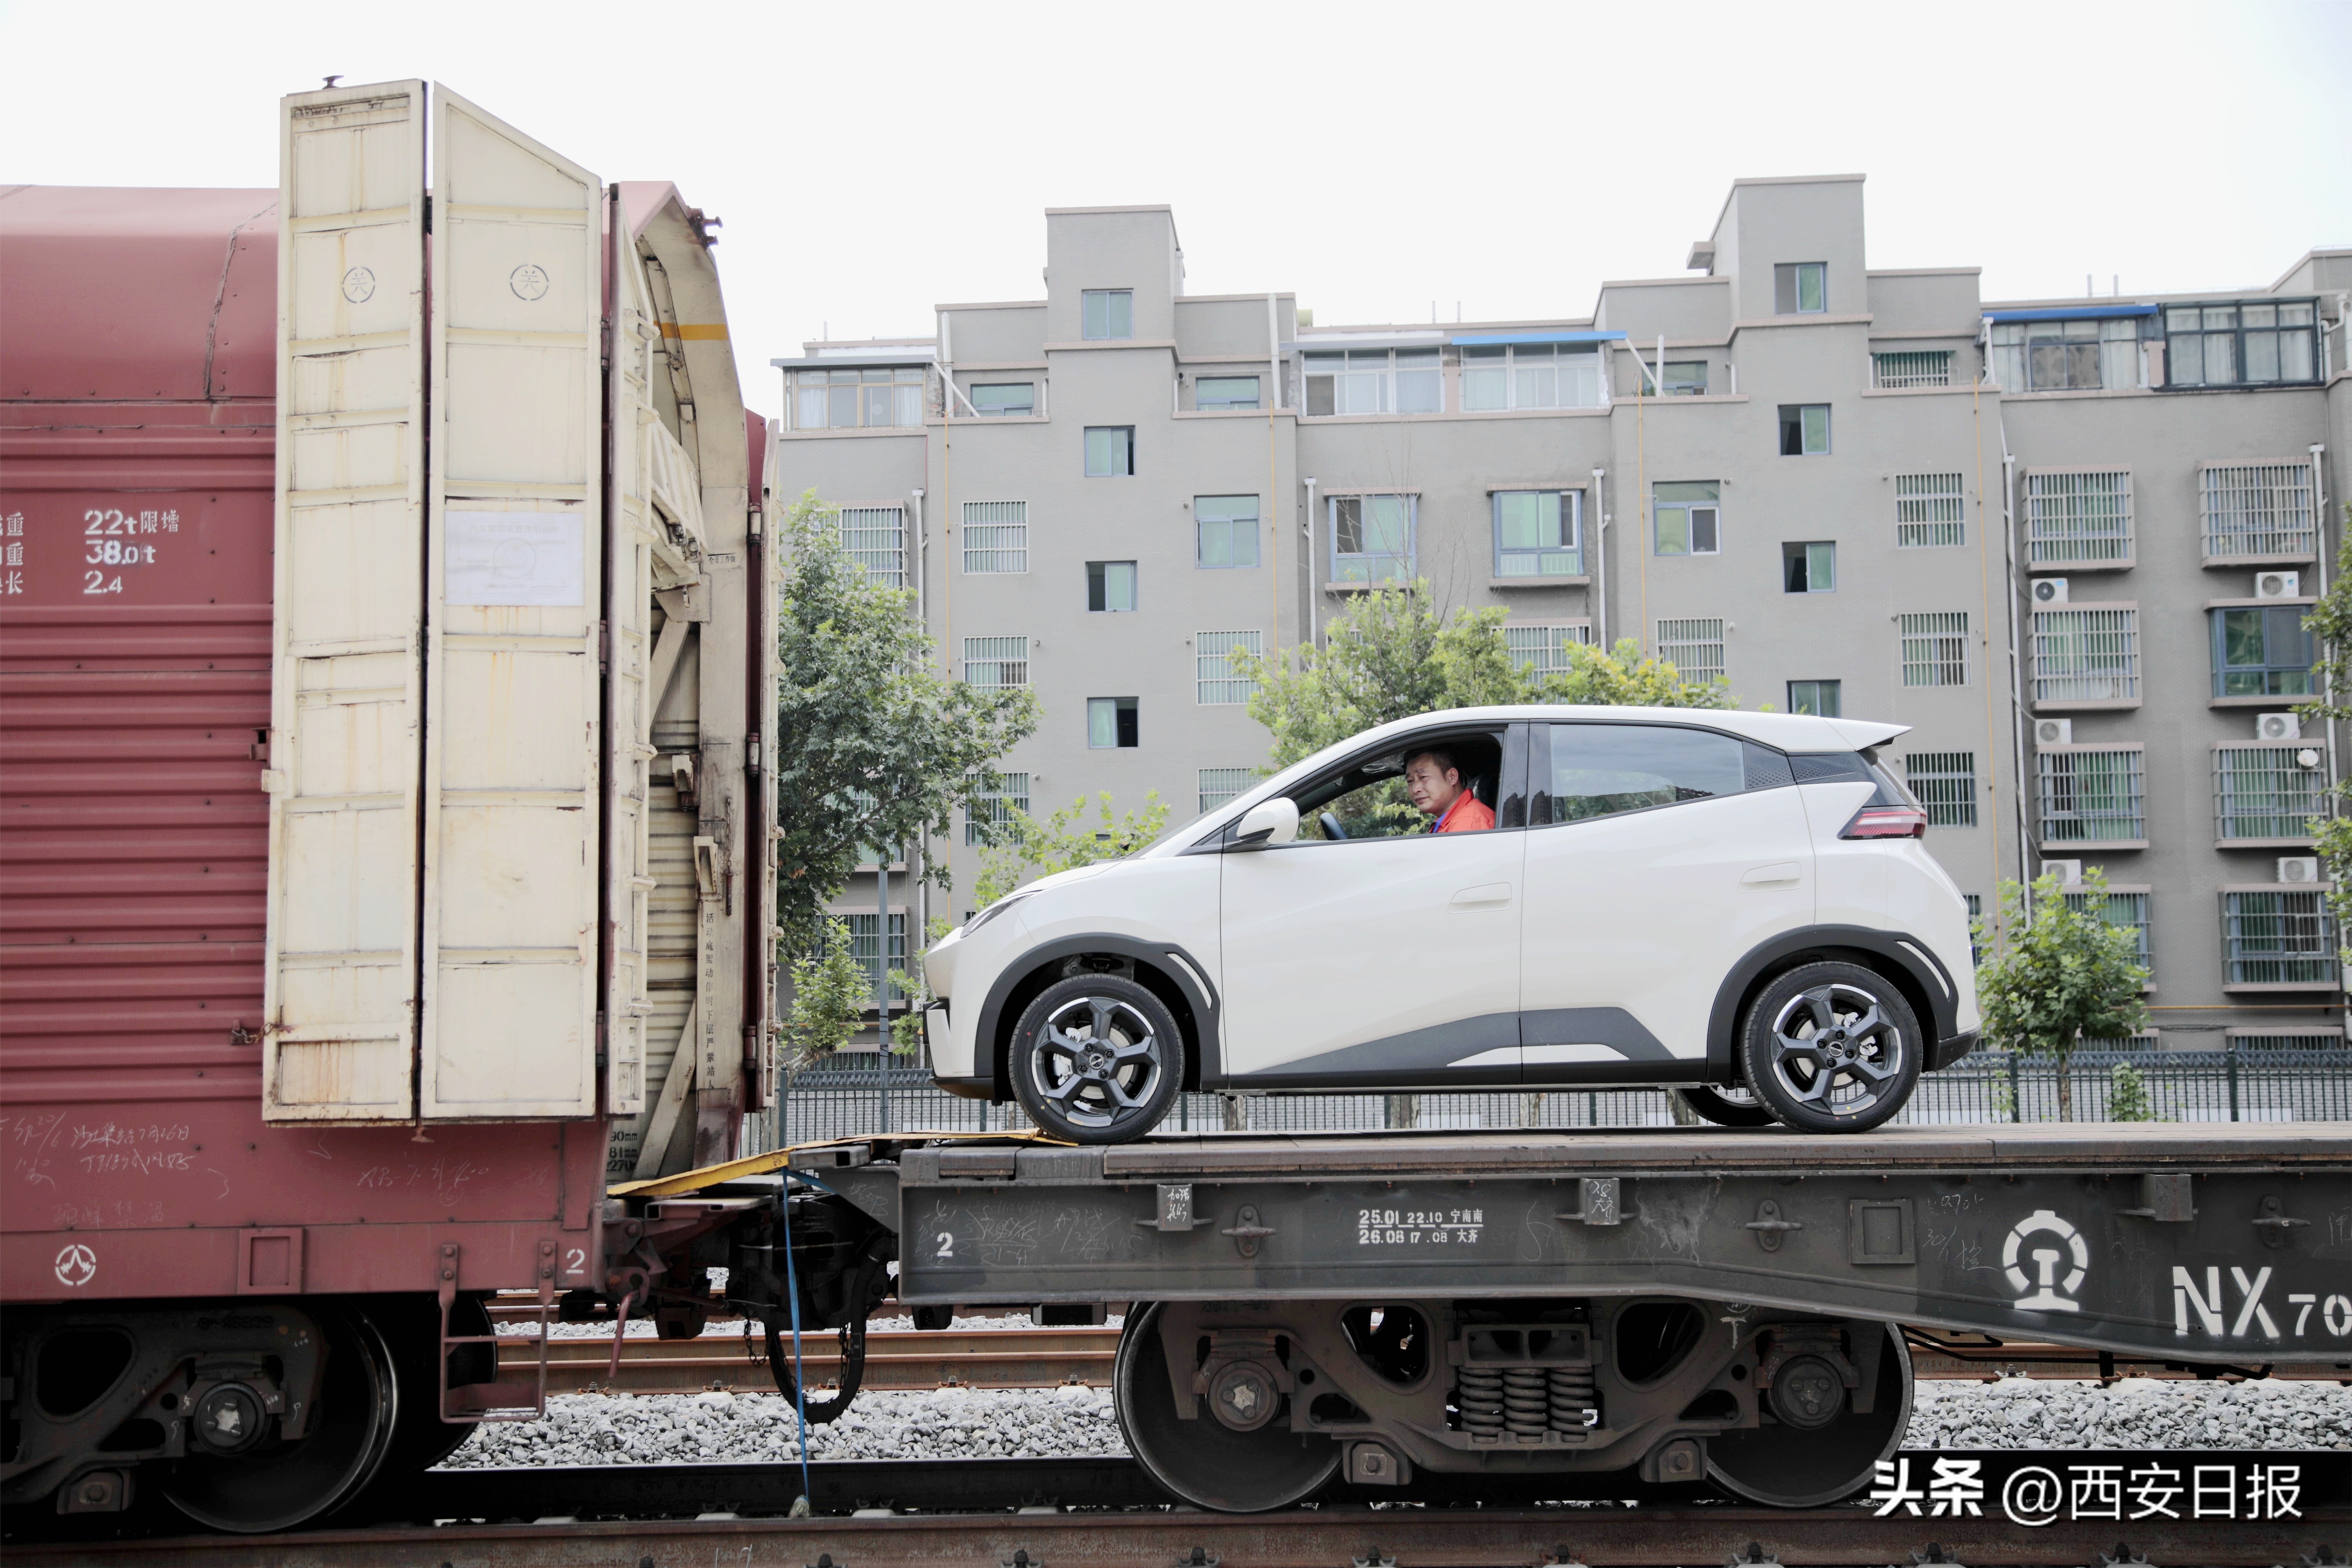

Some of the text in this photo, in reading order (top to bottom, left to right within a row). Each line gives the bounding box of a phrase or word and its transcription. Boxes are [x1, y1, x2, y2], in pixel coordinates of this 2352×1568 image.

[0, 512, 24, 536] 重
[0, 542, 24, 565] 重
[0, 571, 123, 594] 长 2.4
[1359, 1209, 1483, 1225] 25.01 22.10 宁南南
[937, 1232, 953, 1256] 2
[1359, 1229, 1405, 1244] 26.08
[1457, 1229, 1478, 1243] 大齐
[566, 1249, 585, 1274] 2
